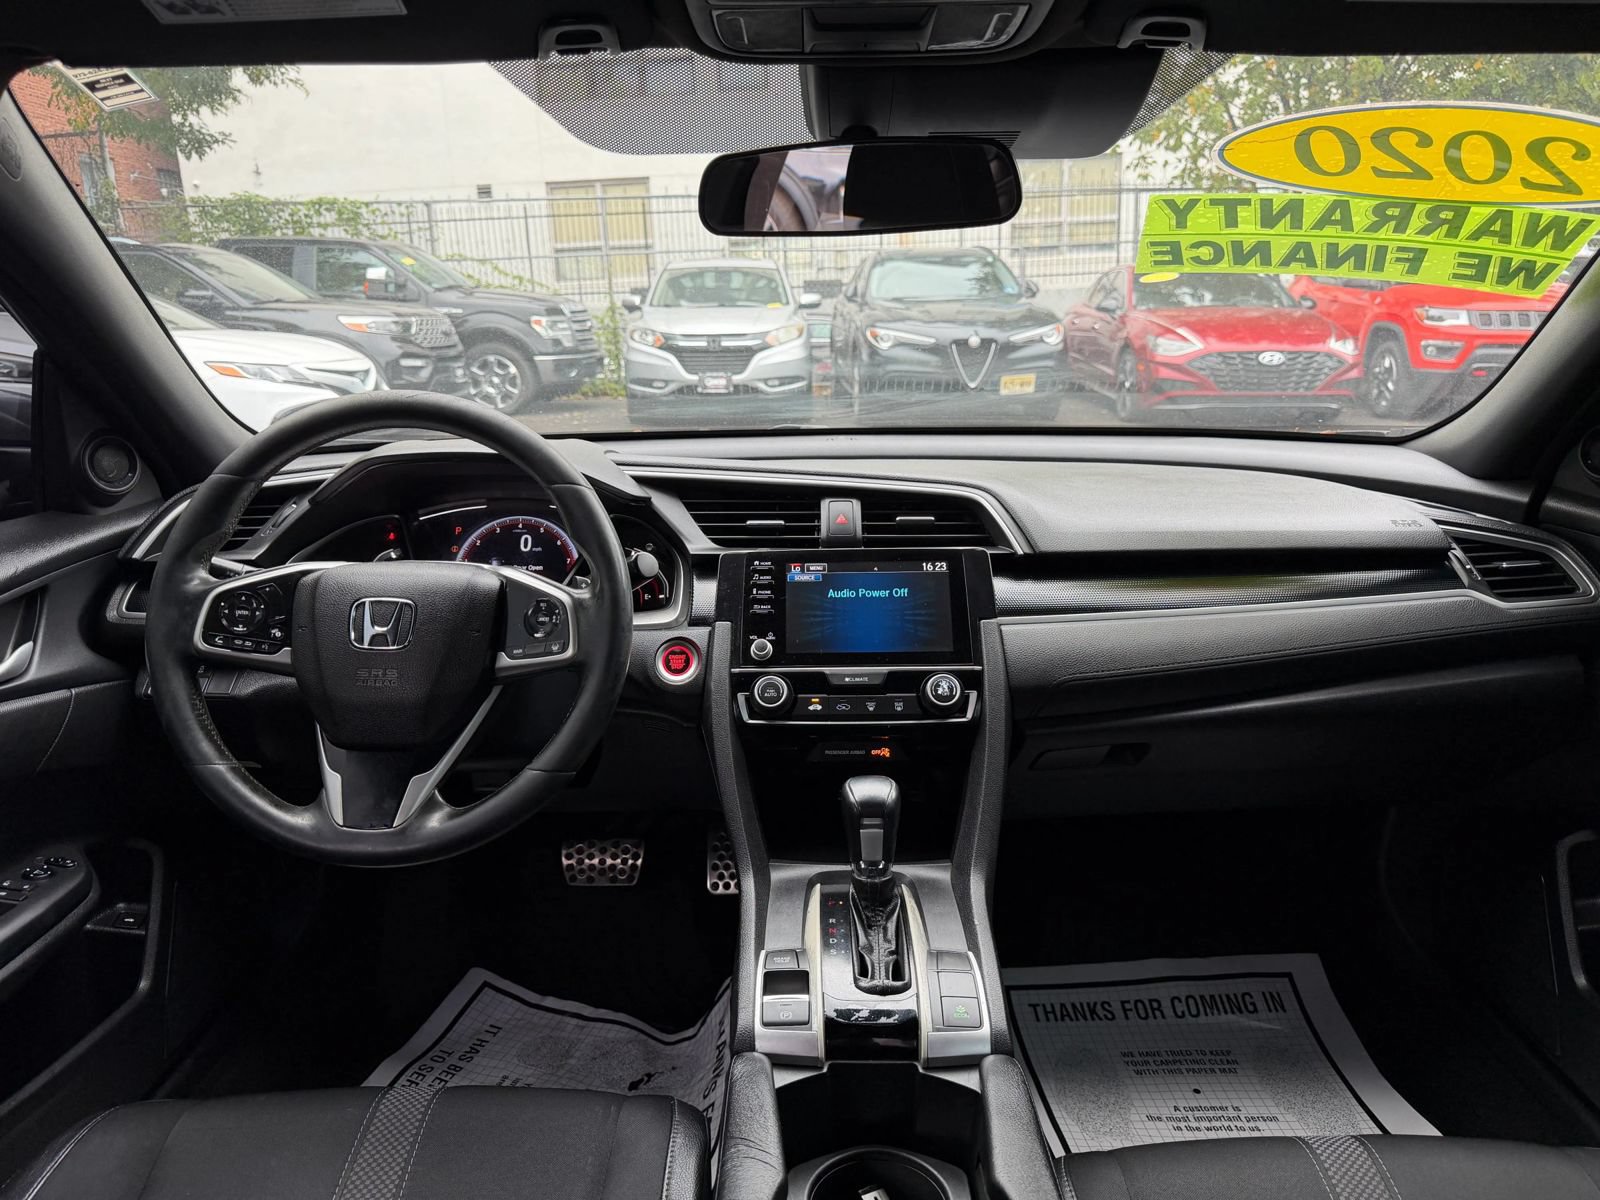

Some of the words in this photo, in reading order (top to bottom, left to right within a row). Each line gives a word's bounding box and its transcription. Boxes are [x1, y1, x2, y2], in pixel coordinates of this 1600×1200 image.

[455, 527, 462, 535] P
[520, 535, 532, 552] 0
[791, 564, 800, 572] Lo
[827, 588, 856, 598] Audio
[859, 588, 890, 598] Power
[892, 587, 909, 597] Off
[357, 668, 398, 678] SRS
[1028, 1001, 1117, 1023] THANKS
[1120, 998, 1166, 1021] FOR
[1171, 992, 1259, 1019] COMING
[1261, 991, 1288, 1013] IN
[485, 1024, 502, 1037] IT
[458, 1038, 489, 1063] HAS
[1138, 1050, 1161, 1058] HAVE
[1165, 1050, 1192, 1058] TRIED
[431, 1049, 455, 1063] TO
[1124, 1059, 1151, 1067] YOUR
[1153, 1058, 1206, 1066] CARPETING
[1208, 1058, 1239, 1066] CLEAN
[428, 1063, 463, 1087] BEE
[1133, 1068, 1160, 1076] WITH
[1173, 1105, 1181, 1113] A
[1183, 1105, 1229, 1113] customer
[1146, 1114, 1163, 1122] the
[1165, 1115, 1191, 1123] most
[1193, 1114, 1243, 1125] important
[1244, 1115, 1280, 1124] person
[1172, 1124, 1183, 1132] in
[1184, 1124, 1201, 1132] the
[1203, 1124, 1234, 1132] world
